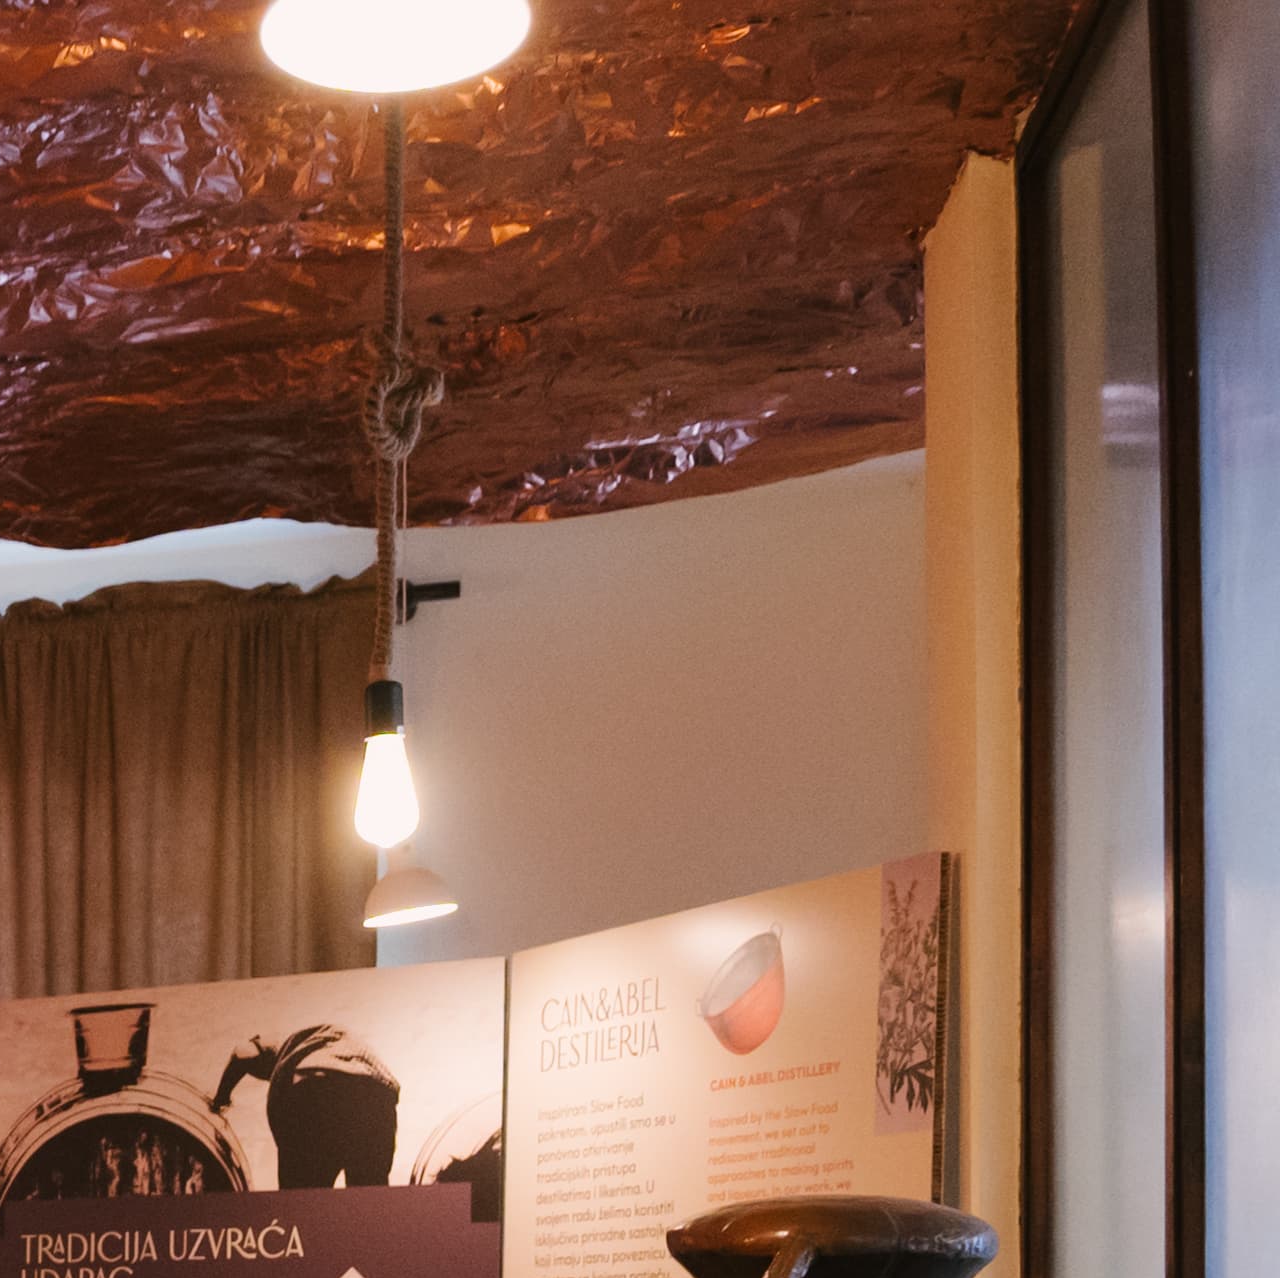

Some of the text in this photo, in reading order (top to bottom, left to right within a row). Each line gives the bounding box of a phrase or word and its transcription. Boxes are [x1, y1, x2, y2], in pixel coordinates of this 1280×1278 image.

[540, 976, 666, 1032] CAIN&ABEL
[540, 1020, 660, 1073] DESTILERIJA
[710, 1078, 736, 1092] CAIN
[748, 1072, 774, 1087] ABEL
[777, 1061, 840, 1082] DISTILLERY
[21, 1219, 304, 1264] TRADICIJA UZVRAĆA
